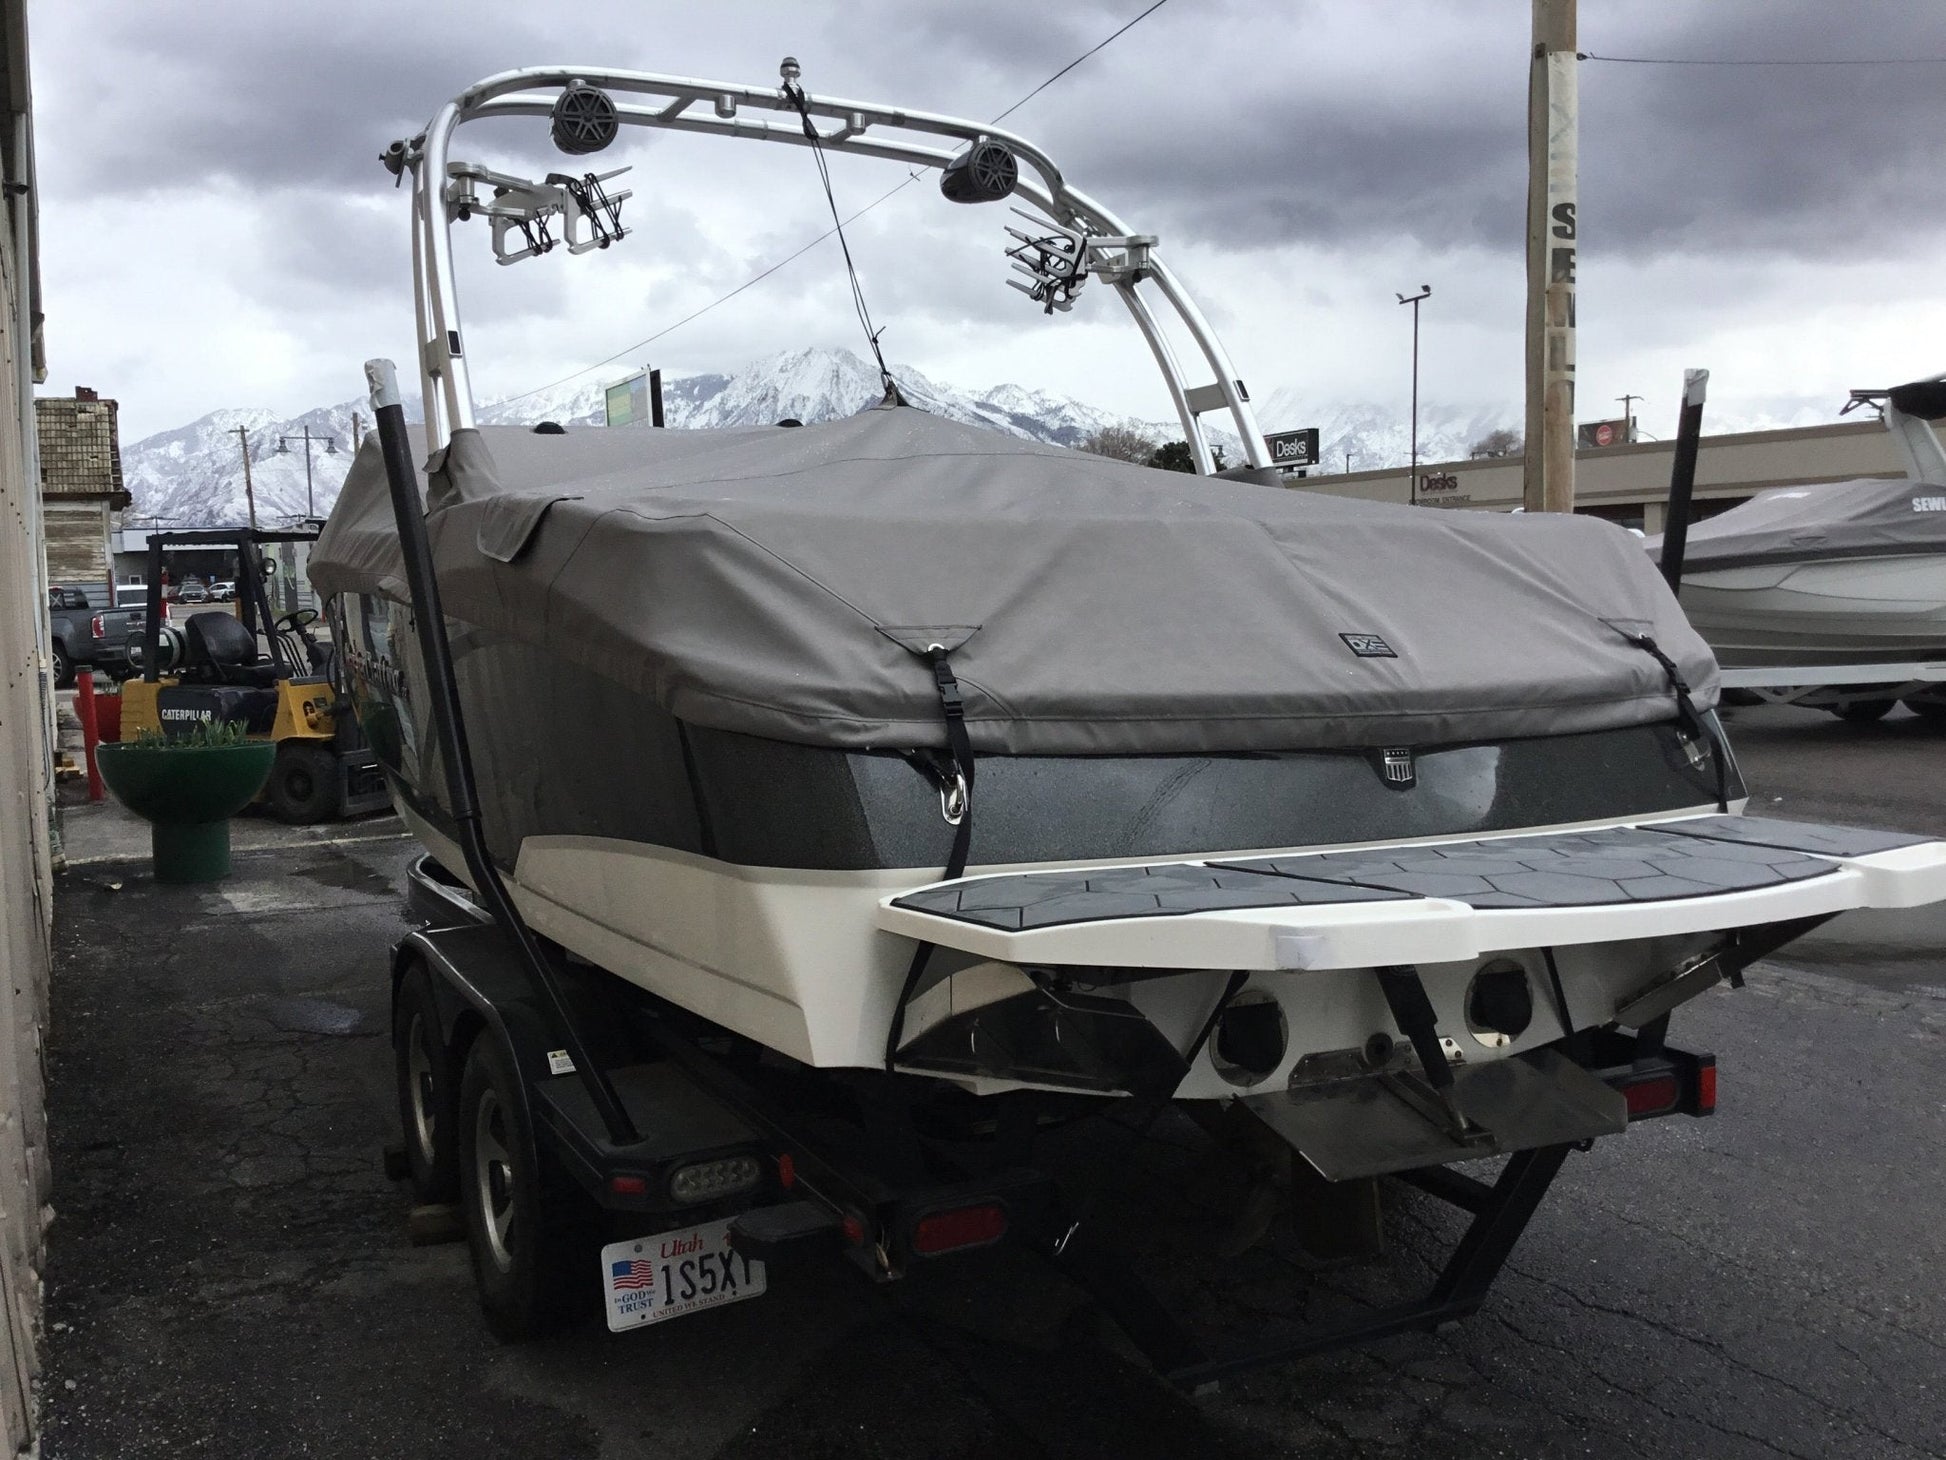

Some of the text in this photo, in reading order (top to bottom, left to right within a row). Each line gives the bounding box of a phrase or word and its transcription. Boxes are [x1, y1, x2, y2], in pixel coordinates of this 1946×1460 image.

[1276, 438, 1306, 457] Desks
[1420, 473, 1458, 491] Desks
[161, 709, 212, 721] CATERPILLAR
[661, 1232, 704, 1259] Utah
[622, 1290, 646, 1303] GOD
[618, 1298, 654, 1314] TRUST
[653, 1304, 683, 1318] UNITED
[698, 1294, 725, 1306] STAND
